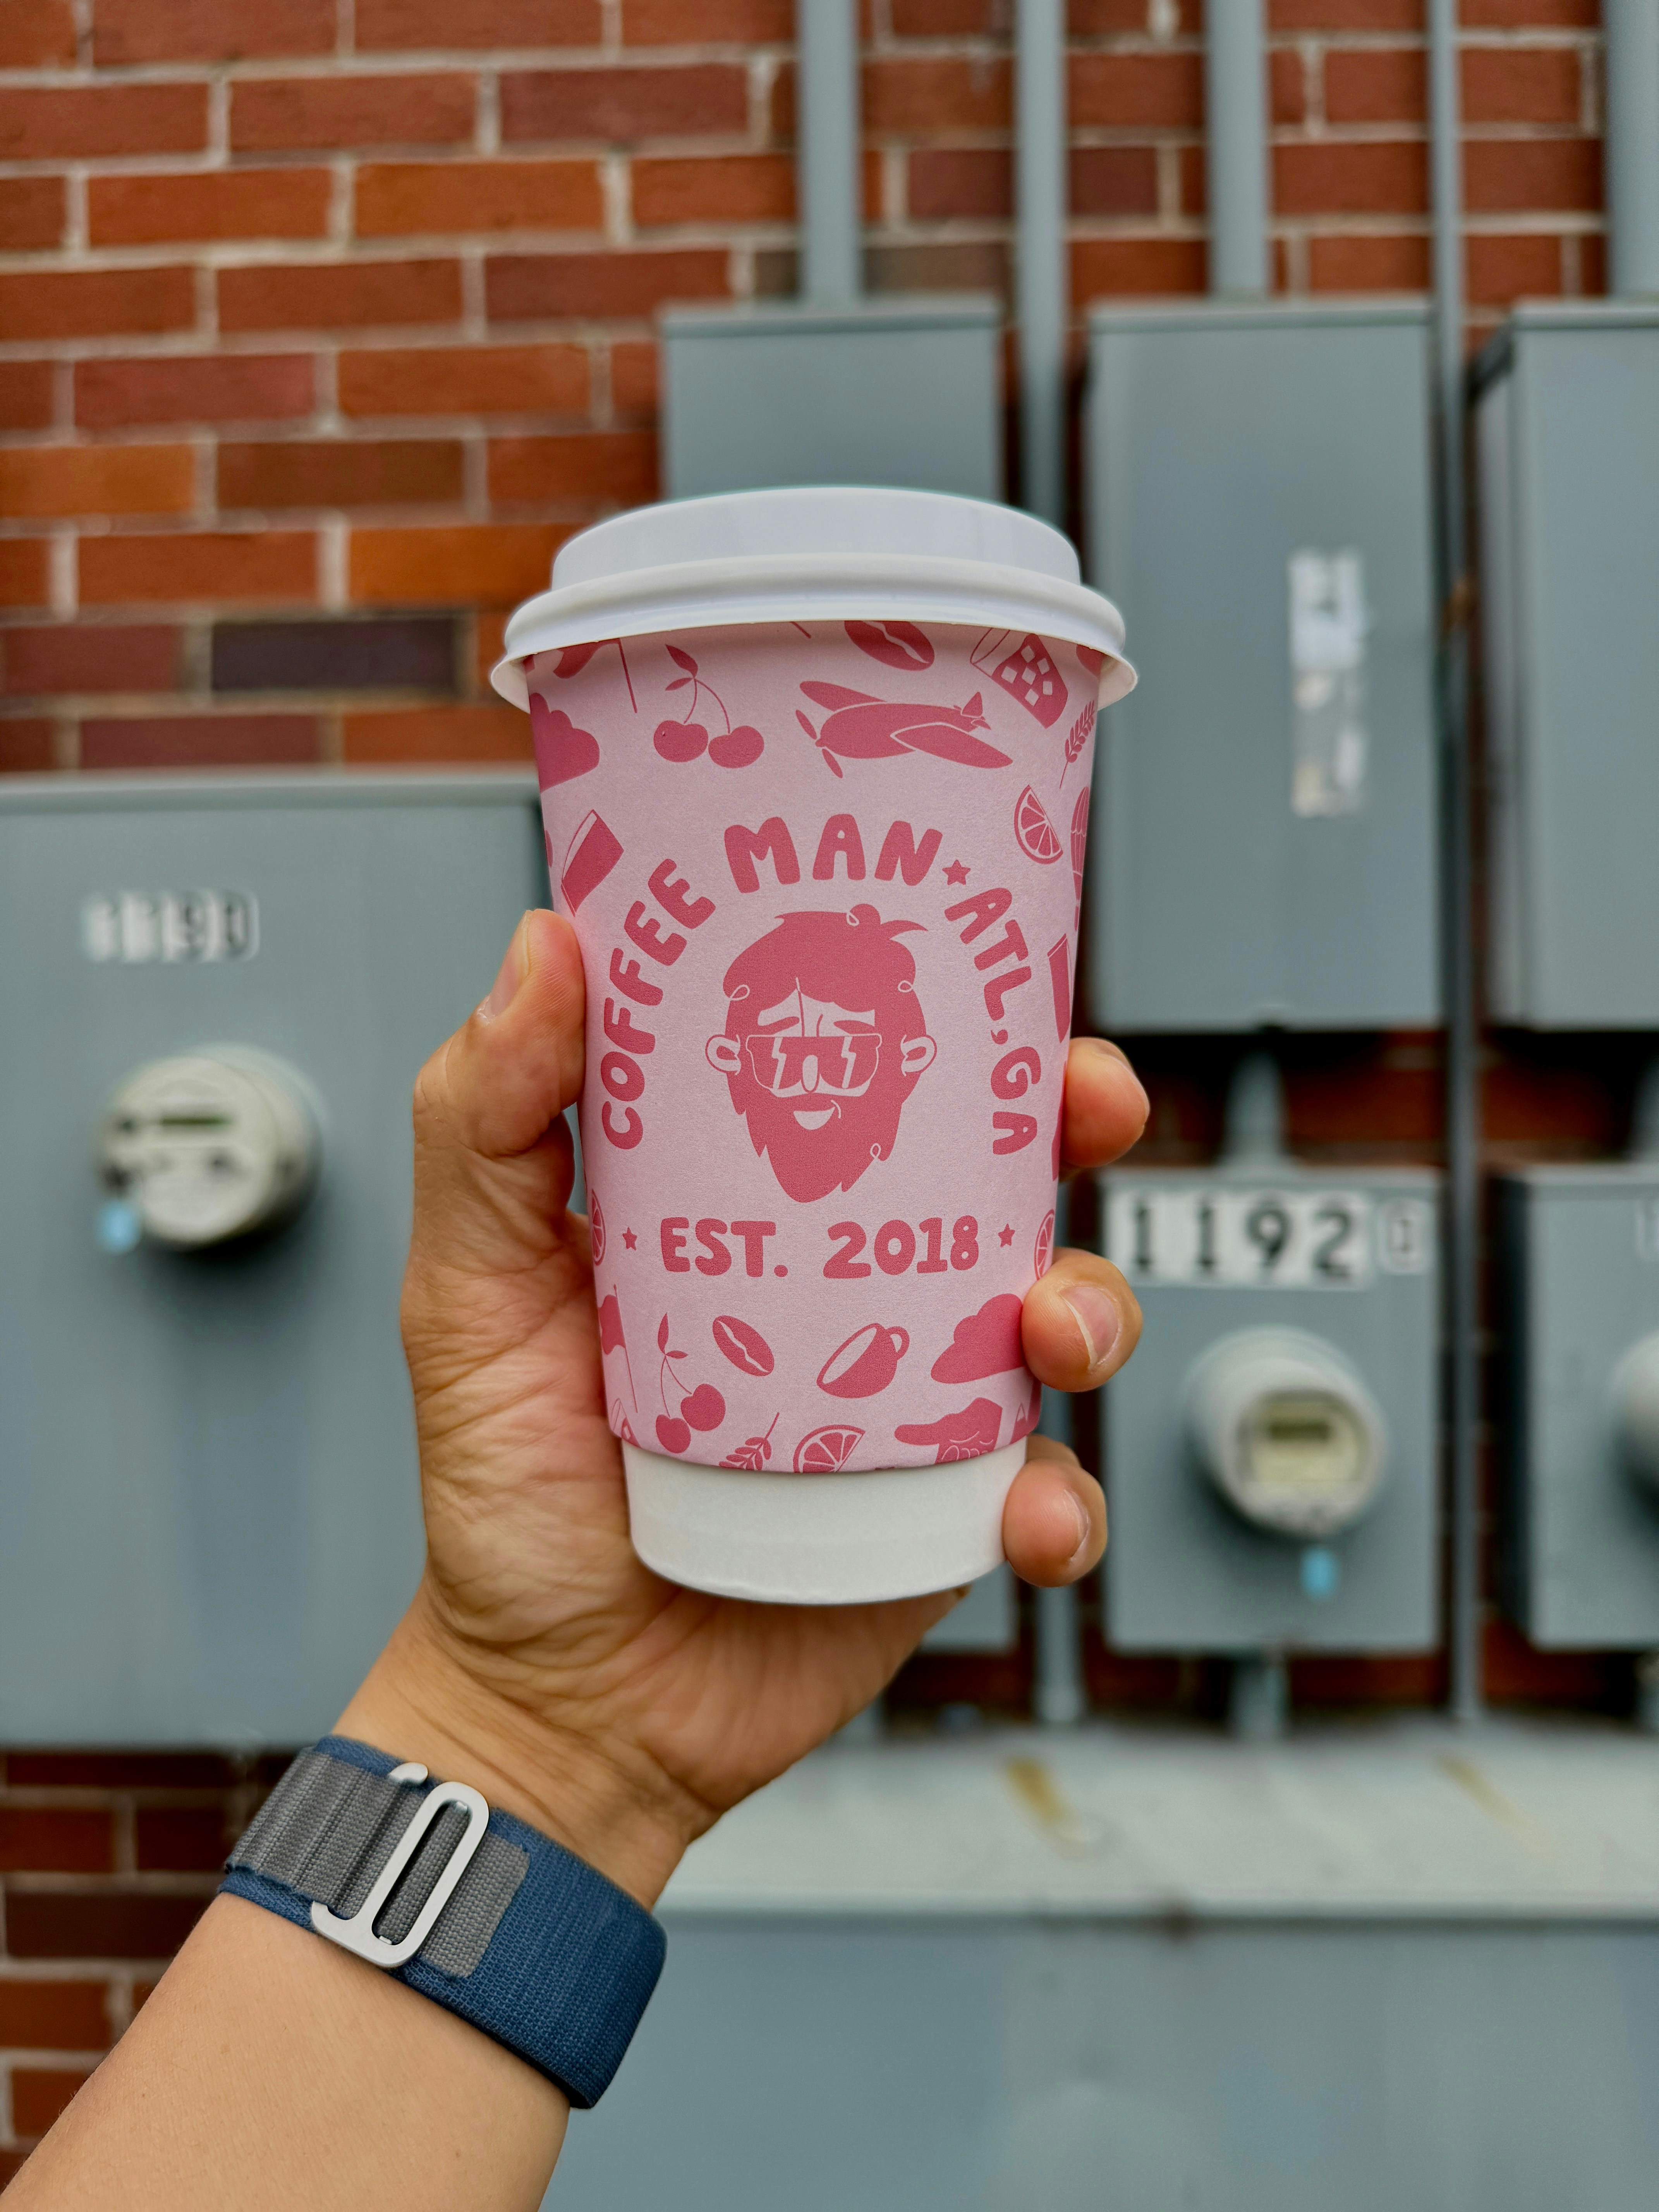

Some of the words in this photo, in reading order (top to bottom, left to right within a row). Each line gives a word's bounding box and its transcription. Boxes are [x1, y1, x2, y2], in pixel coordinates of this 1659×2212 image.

[600, 859, 716, 1150] COFFEE
[724, 814, 943, 893] MAN
[660, 1217, 788, 1278] EST.
[823, 1215, 979, 1279] 2018
[1130, 1197, 1353, 1279] 1192
